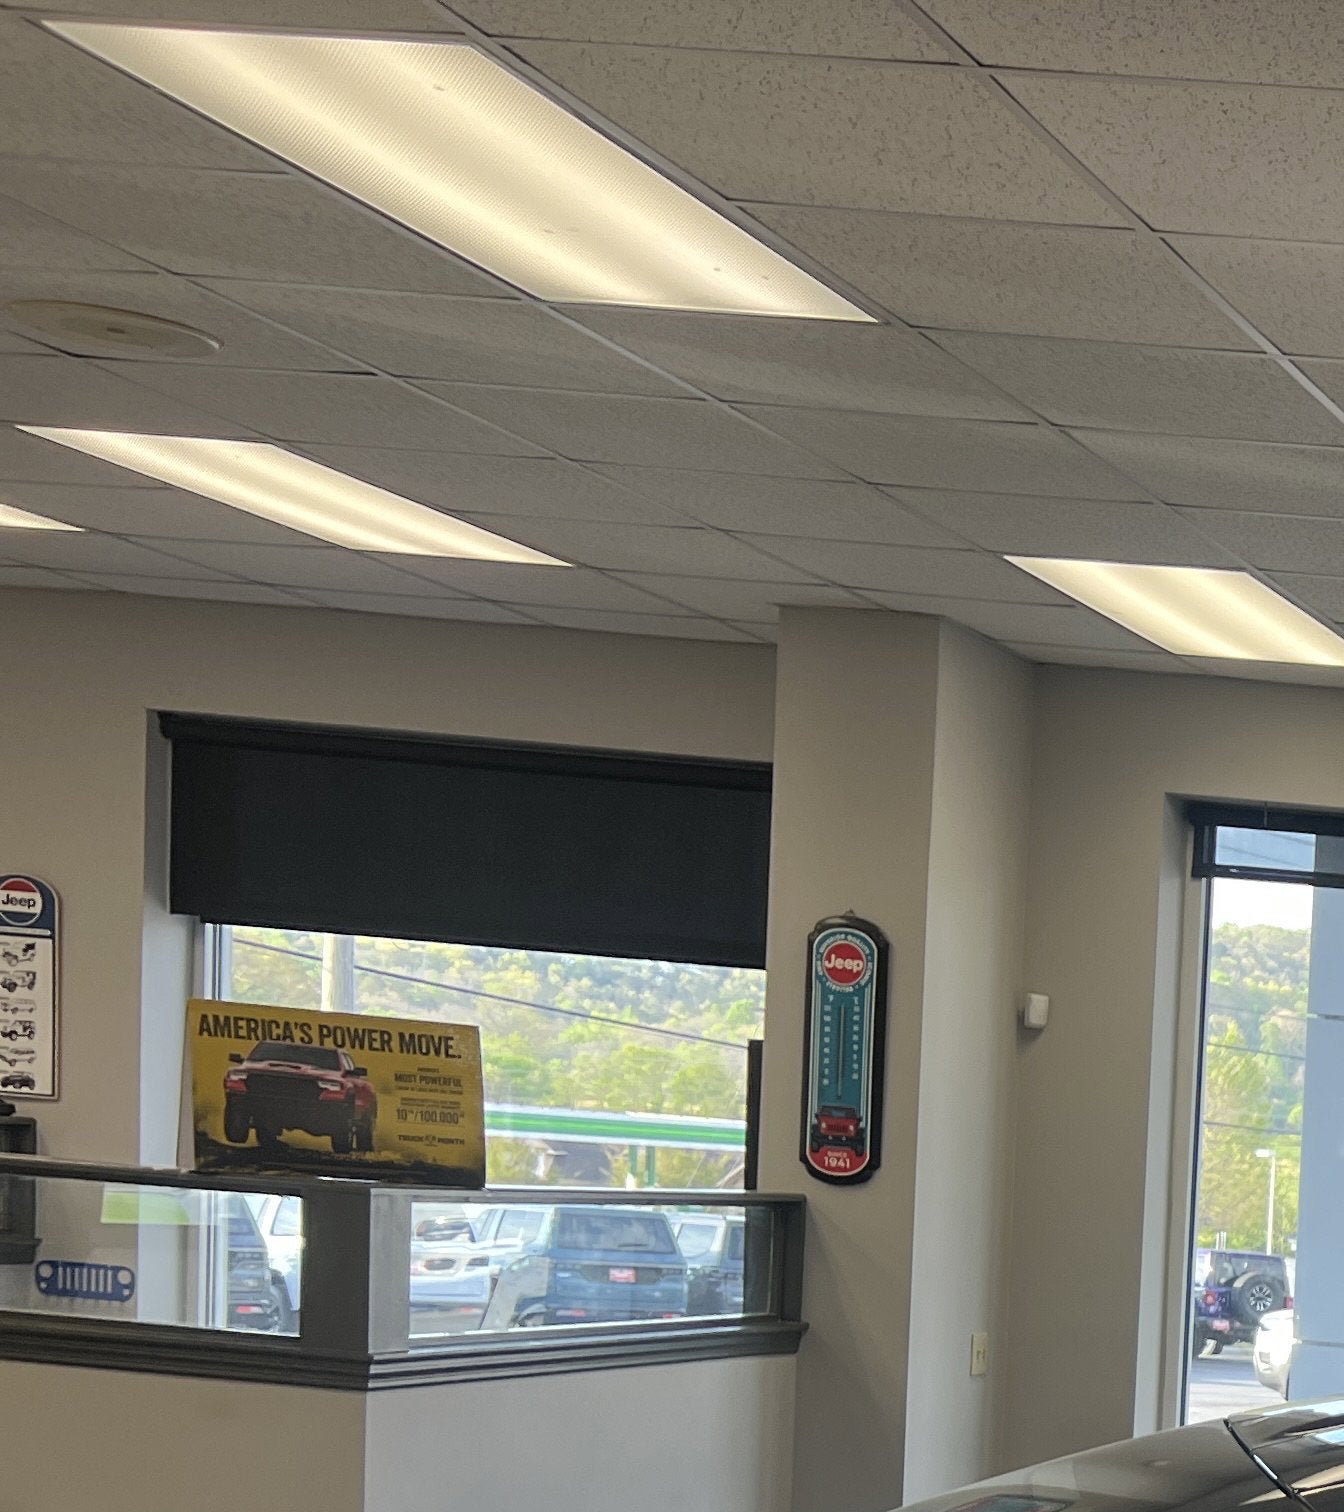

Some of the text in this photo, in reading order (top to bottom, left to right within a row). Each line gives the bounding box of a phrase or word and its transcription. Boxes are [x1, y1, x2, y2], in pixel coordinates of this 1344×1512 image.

[1, 893, 36, 909] Jeep
[824, 953, 864, 974] Jeep
[199, 1013, 463, 1060] AMERICA'S POWER MOVE.
[823, 1156, 851, 1168] 1941
